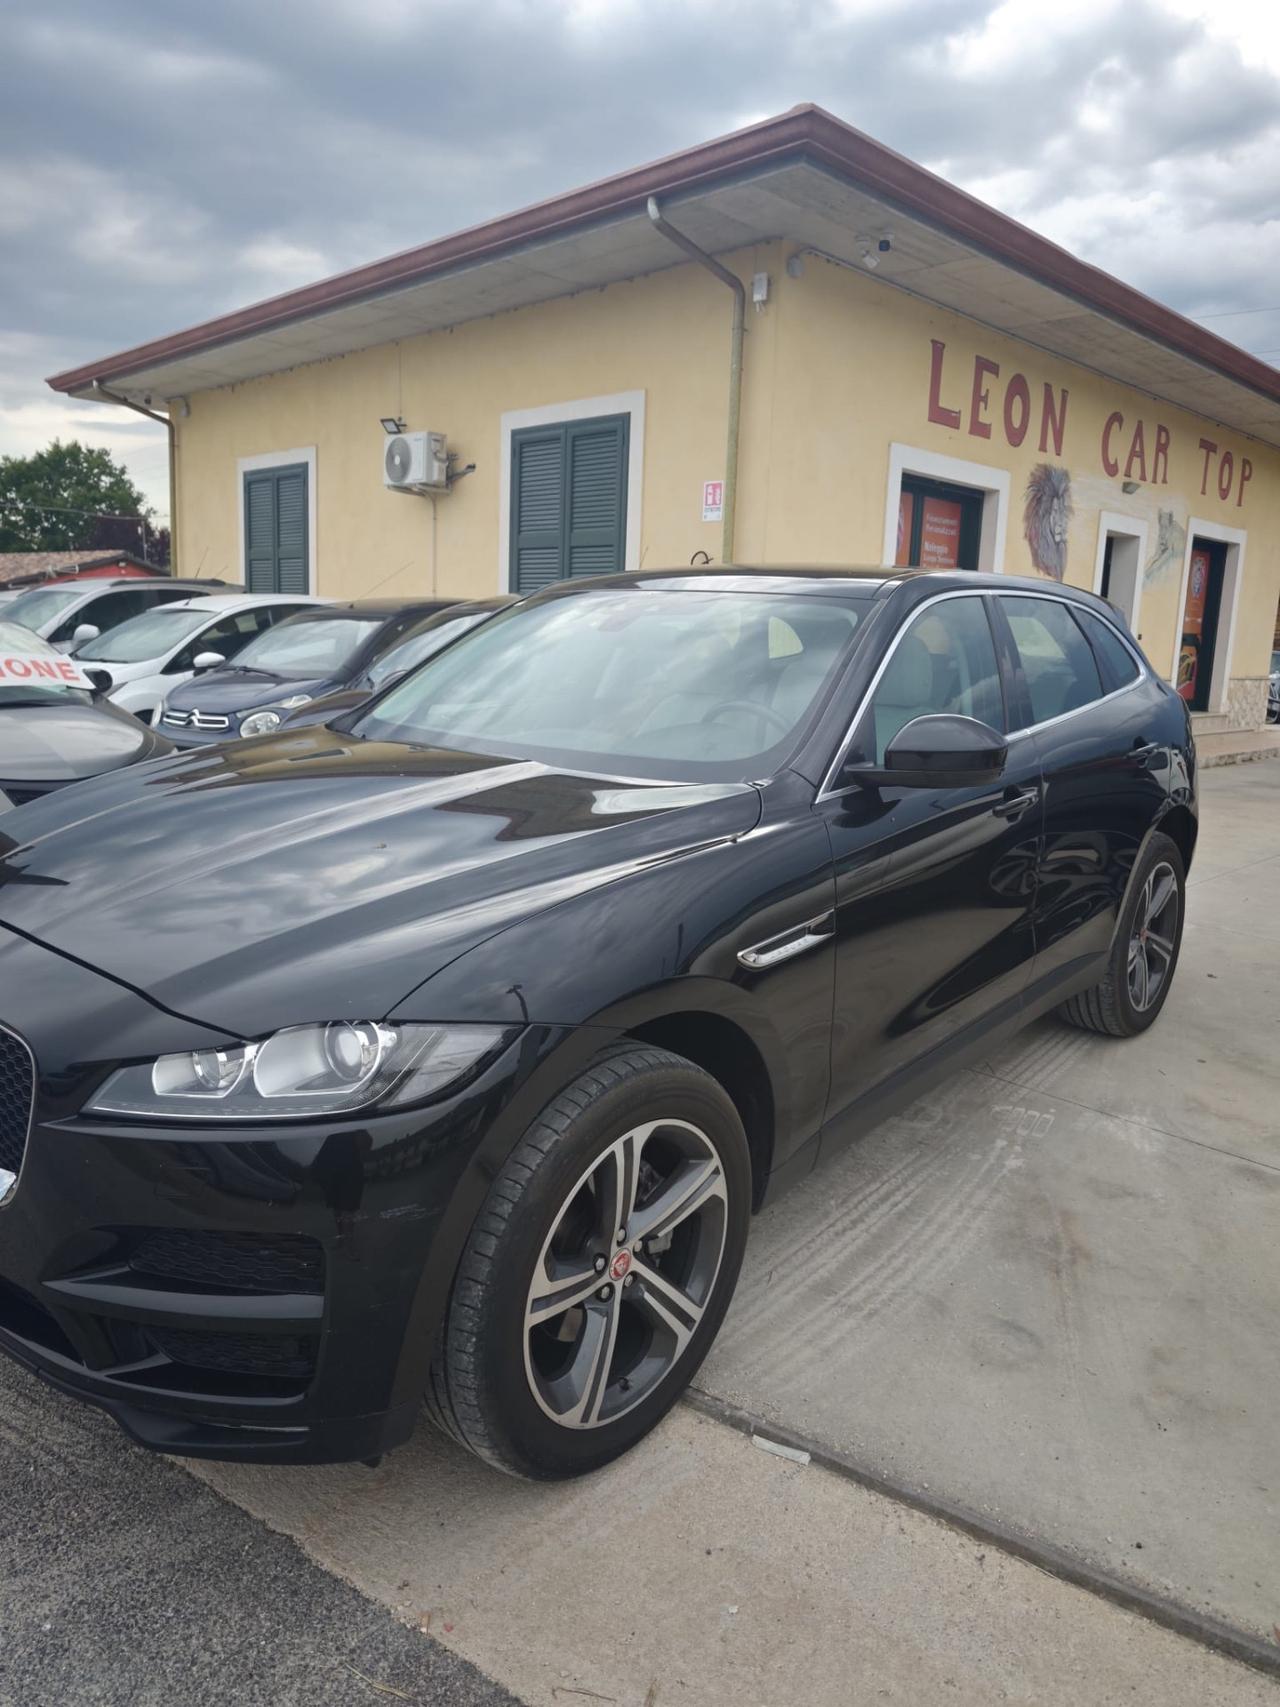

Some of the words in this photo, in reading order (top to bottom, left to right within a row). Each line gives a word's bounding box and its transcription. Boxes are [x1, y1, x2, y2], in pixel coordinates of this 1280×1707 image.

[928, 339, 1069, 457] LEON
[1101, 411, 1170, 484] CAR
[1199, 438, 1253, 507] TOP
